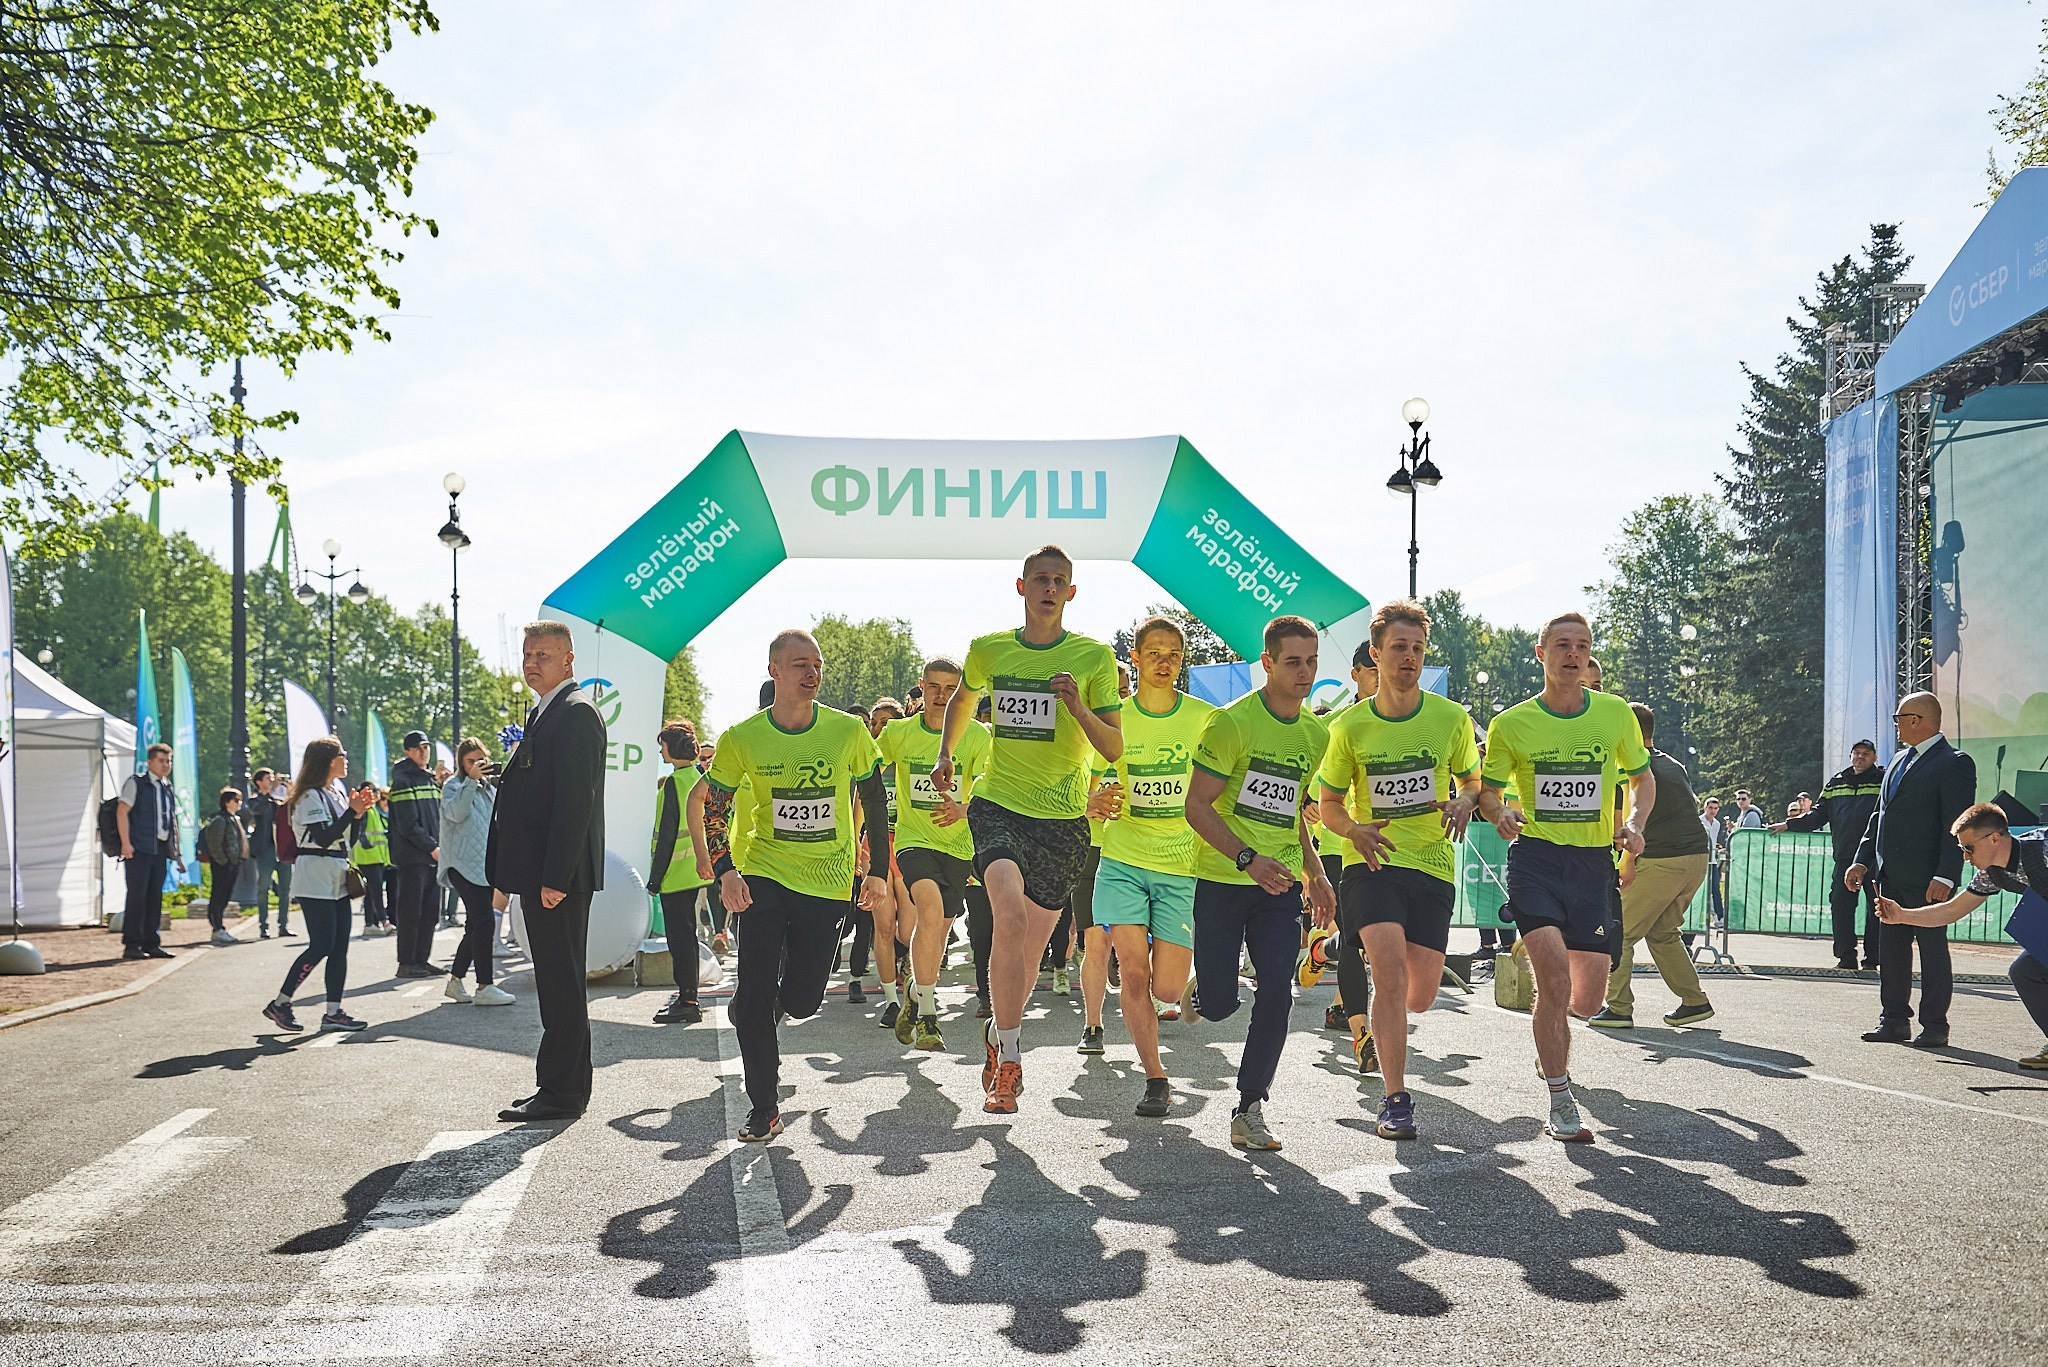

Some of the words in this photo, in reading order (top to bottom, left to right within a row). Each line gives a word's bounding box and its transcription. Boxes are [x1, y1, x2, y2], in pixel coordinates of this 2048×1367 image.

[1968, 265, 2008, 309] СБЕР
[811, 465, 1107, 519] ФИНИШ
[624, 497, 724, 590] зелёный
[1202, 508, 1301, 596] зелёный
[640, 518, 740, 609] марафон
[1185, 525, 1283, 613] марафон
[998, 697, 1049, 716] 42311
[605, 742, 644, 772] ЕР
[1133, 781, 1182, 796] 42306
[1247, 779, 1294, 802] 42330
[1375, 776, 1429, 796] 42323
[1540, 781, 1596, 797] 42309
[778, 804, 830, 820] 42312
[1463, 863, 1509, 883] СБЕ
